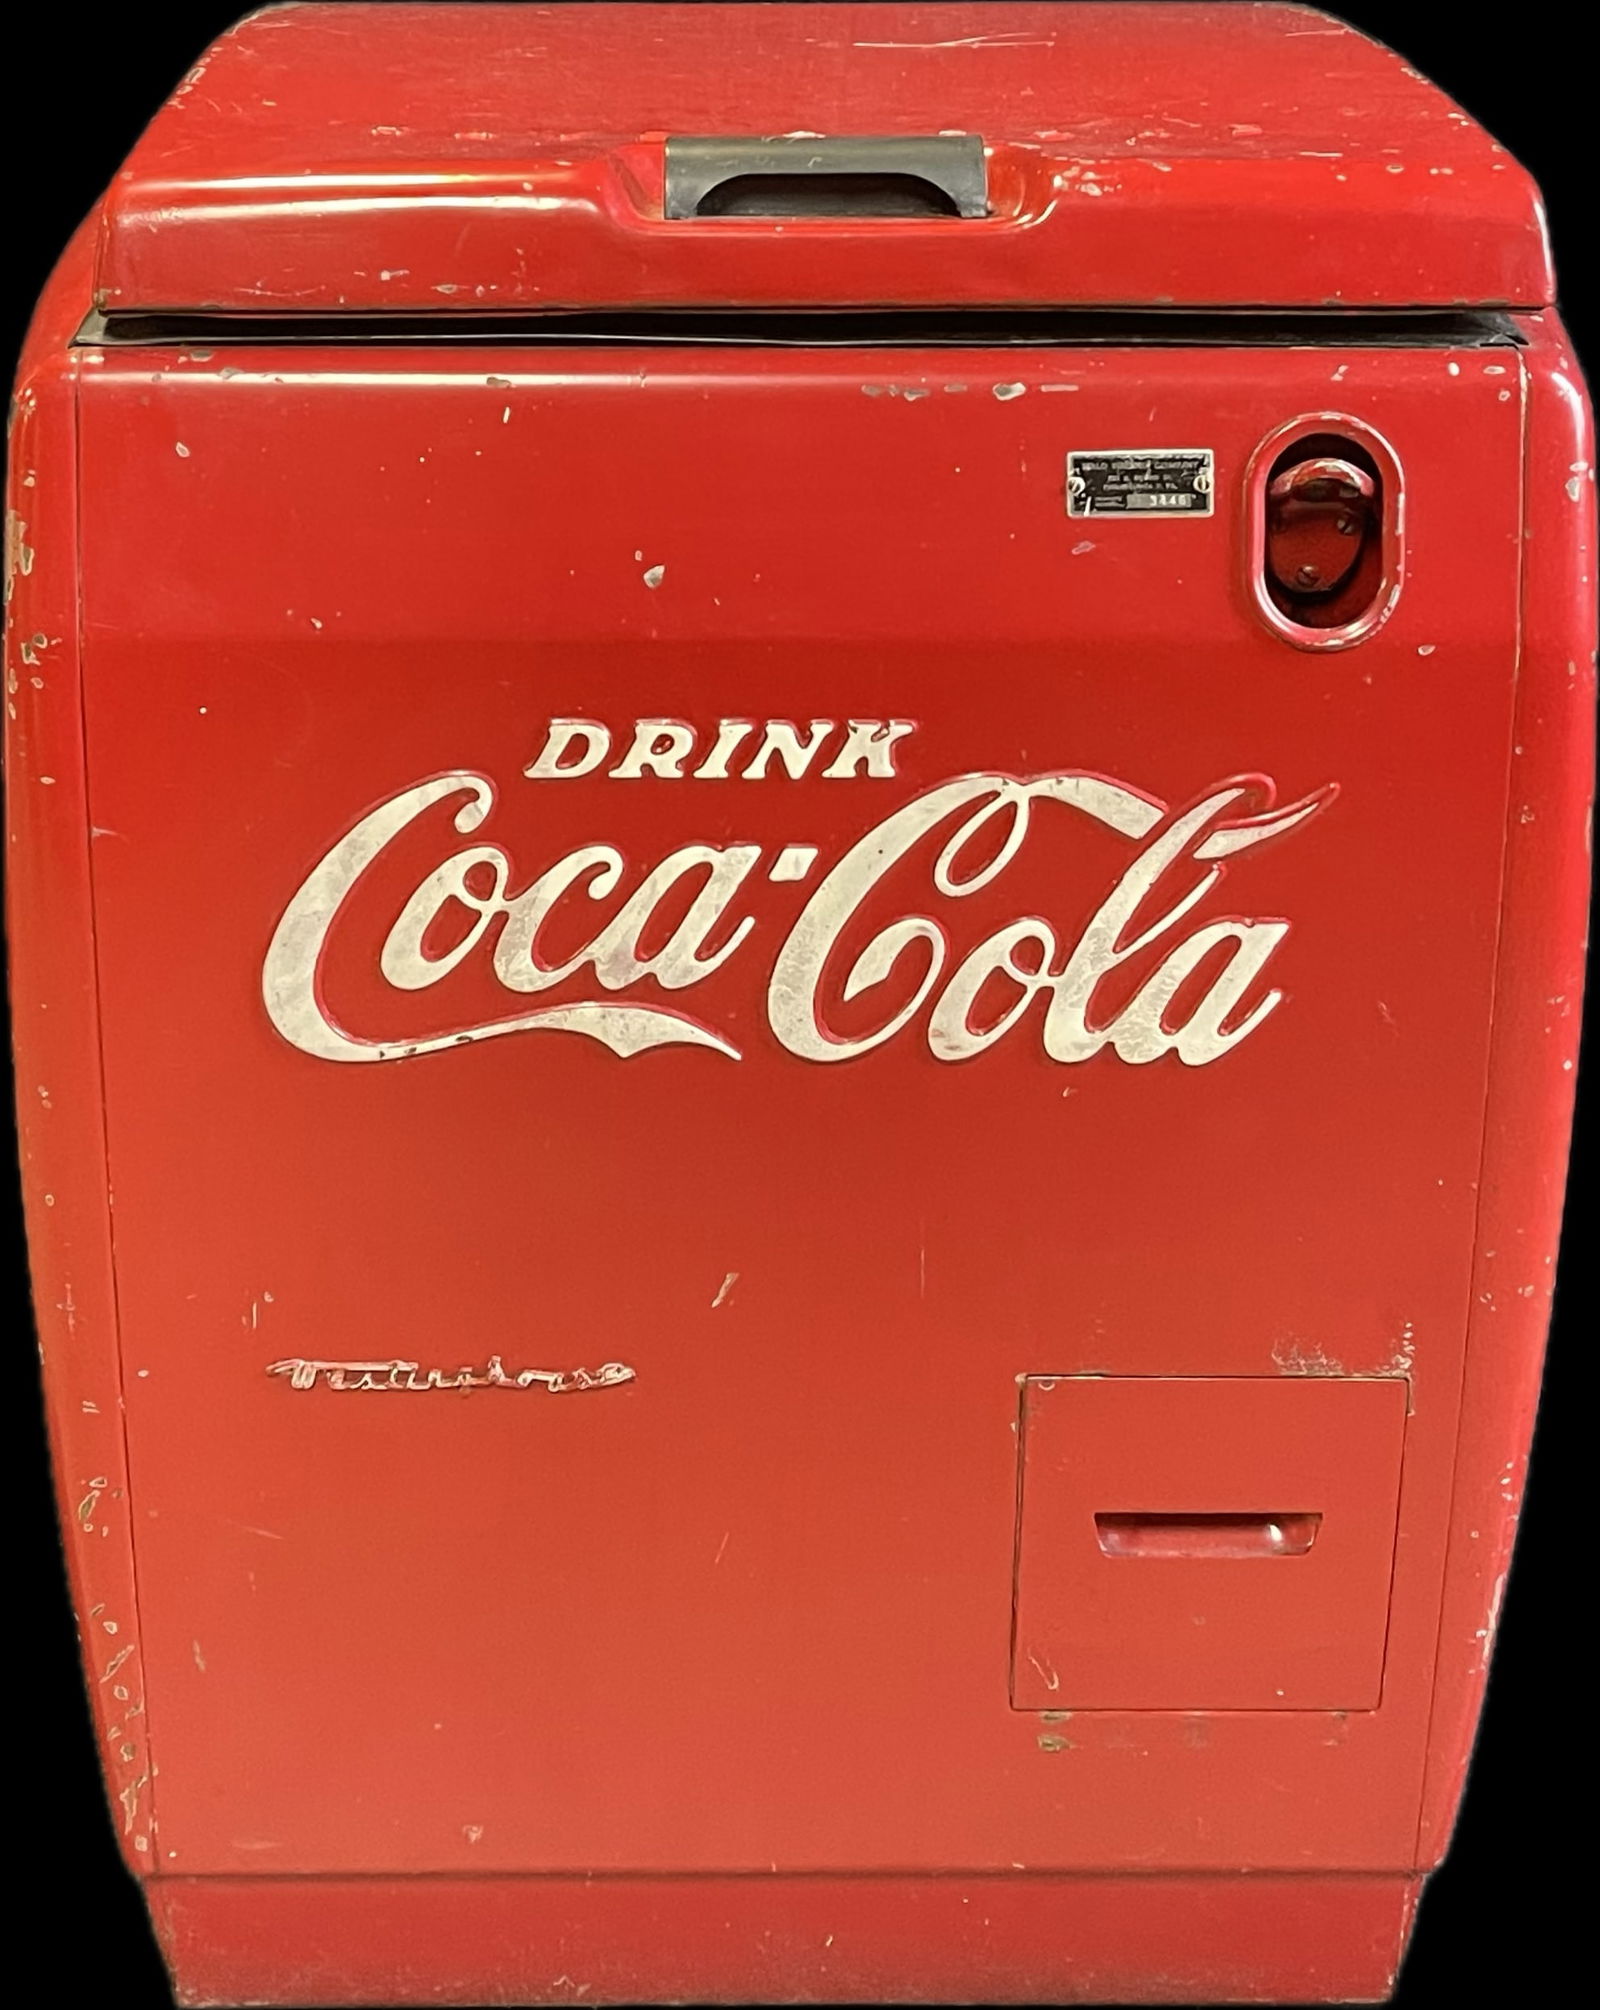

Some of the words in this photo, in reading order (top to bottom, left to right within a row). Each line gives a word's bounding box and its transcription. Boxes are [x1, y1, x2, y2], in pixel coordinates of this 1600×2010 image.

[525, 717, 917, 780] DRINK
[262, 770, 1339, 1066] Coca-Cola
[266, 1355, 636, 1395] Westinghouse
